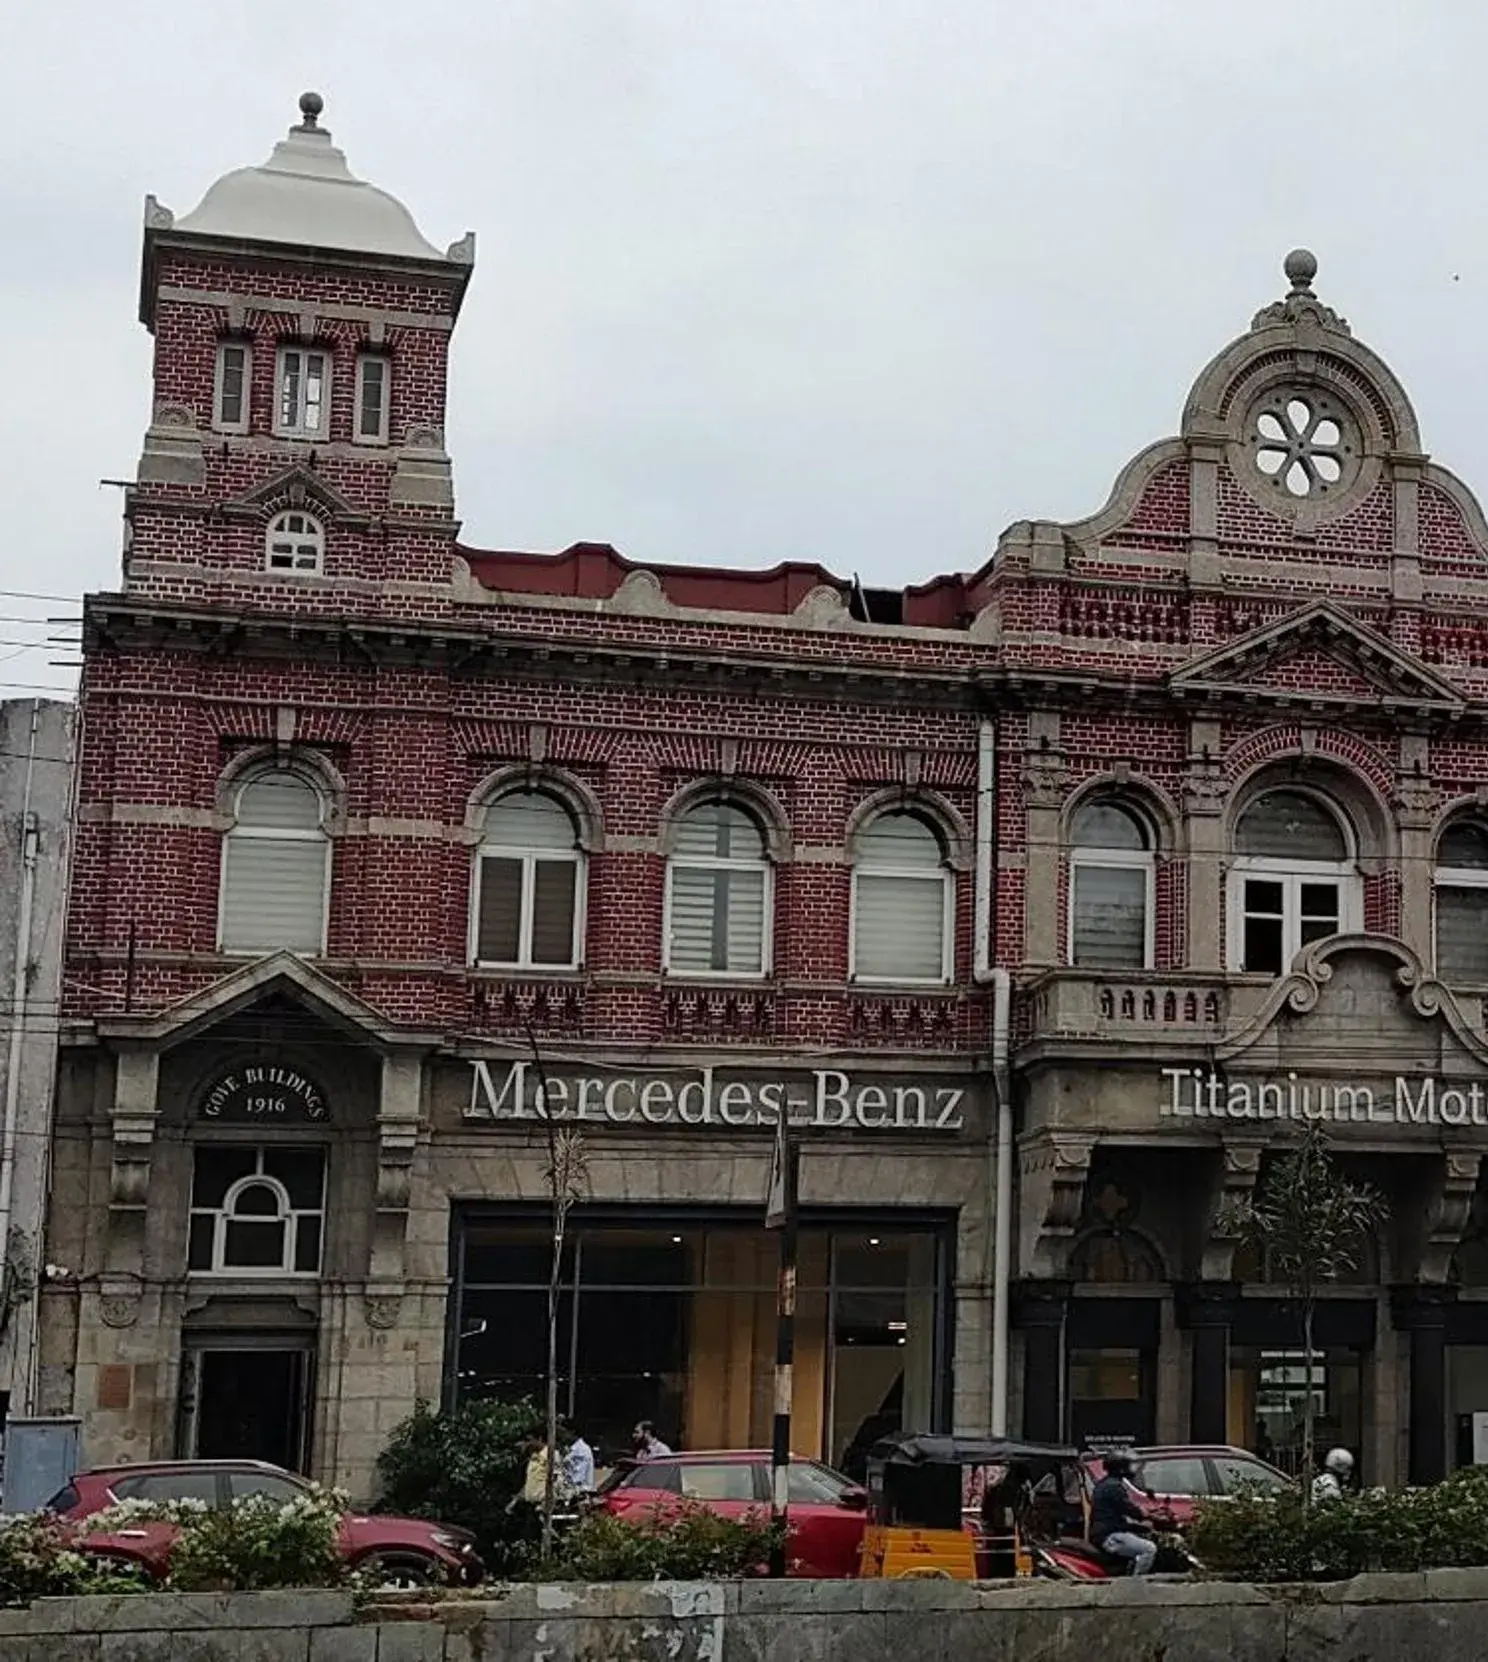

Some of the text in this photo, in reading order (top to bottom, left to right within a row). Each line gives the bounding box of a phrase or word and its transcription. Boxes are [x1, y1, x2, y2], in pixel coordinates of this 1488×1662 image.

[245, 1067, 324, 1118] BUILDINGS
[246, 1097, 286, 1113] 1916
[467, 1059, 966, 1130] Mercedes-Benz
[1162, 1067, 1374, 1121] Titanium
